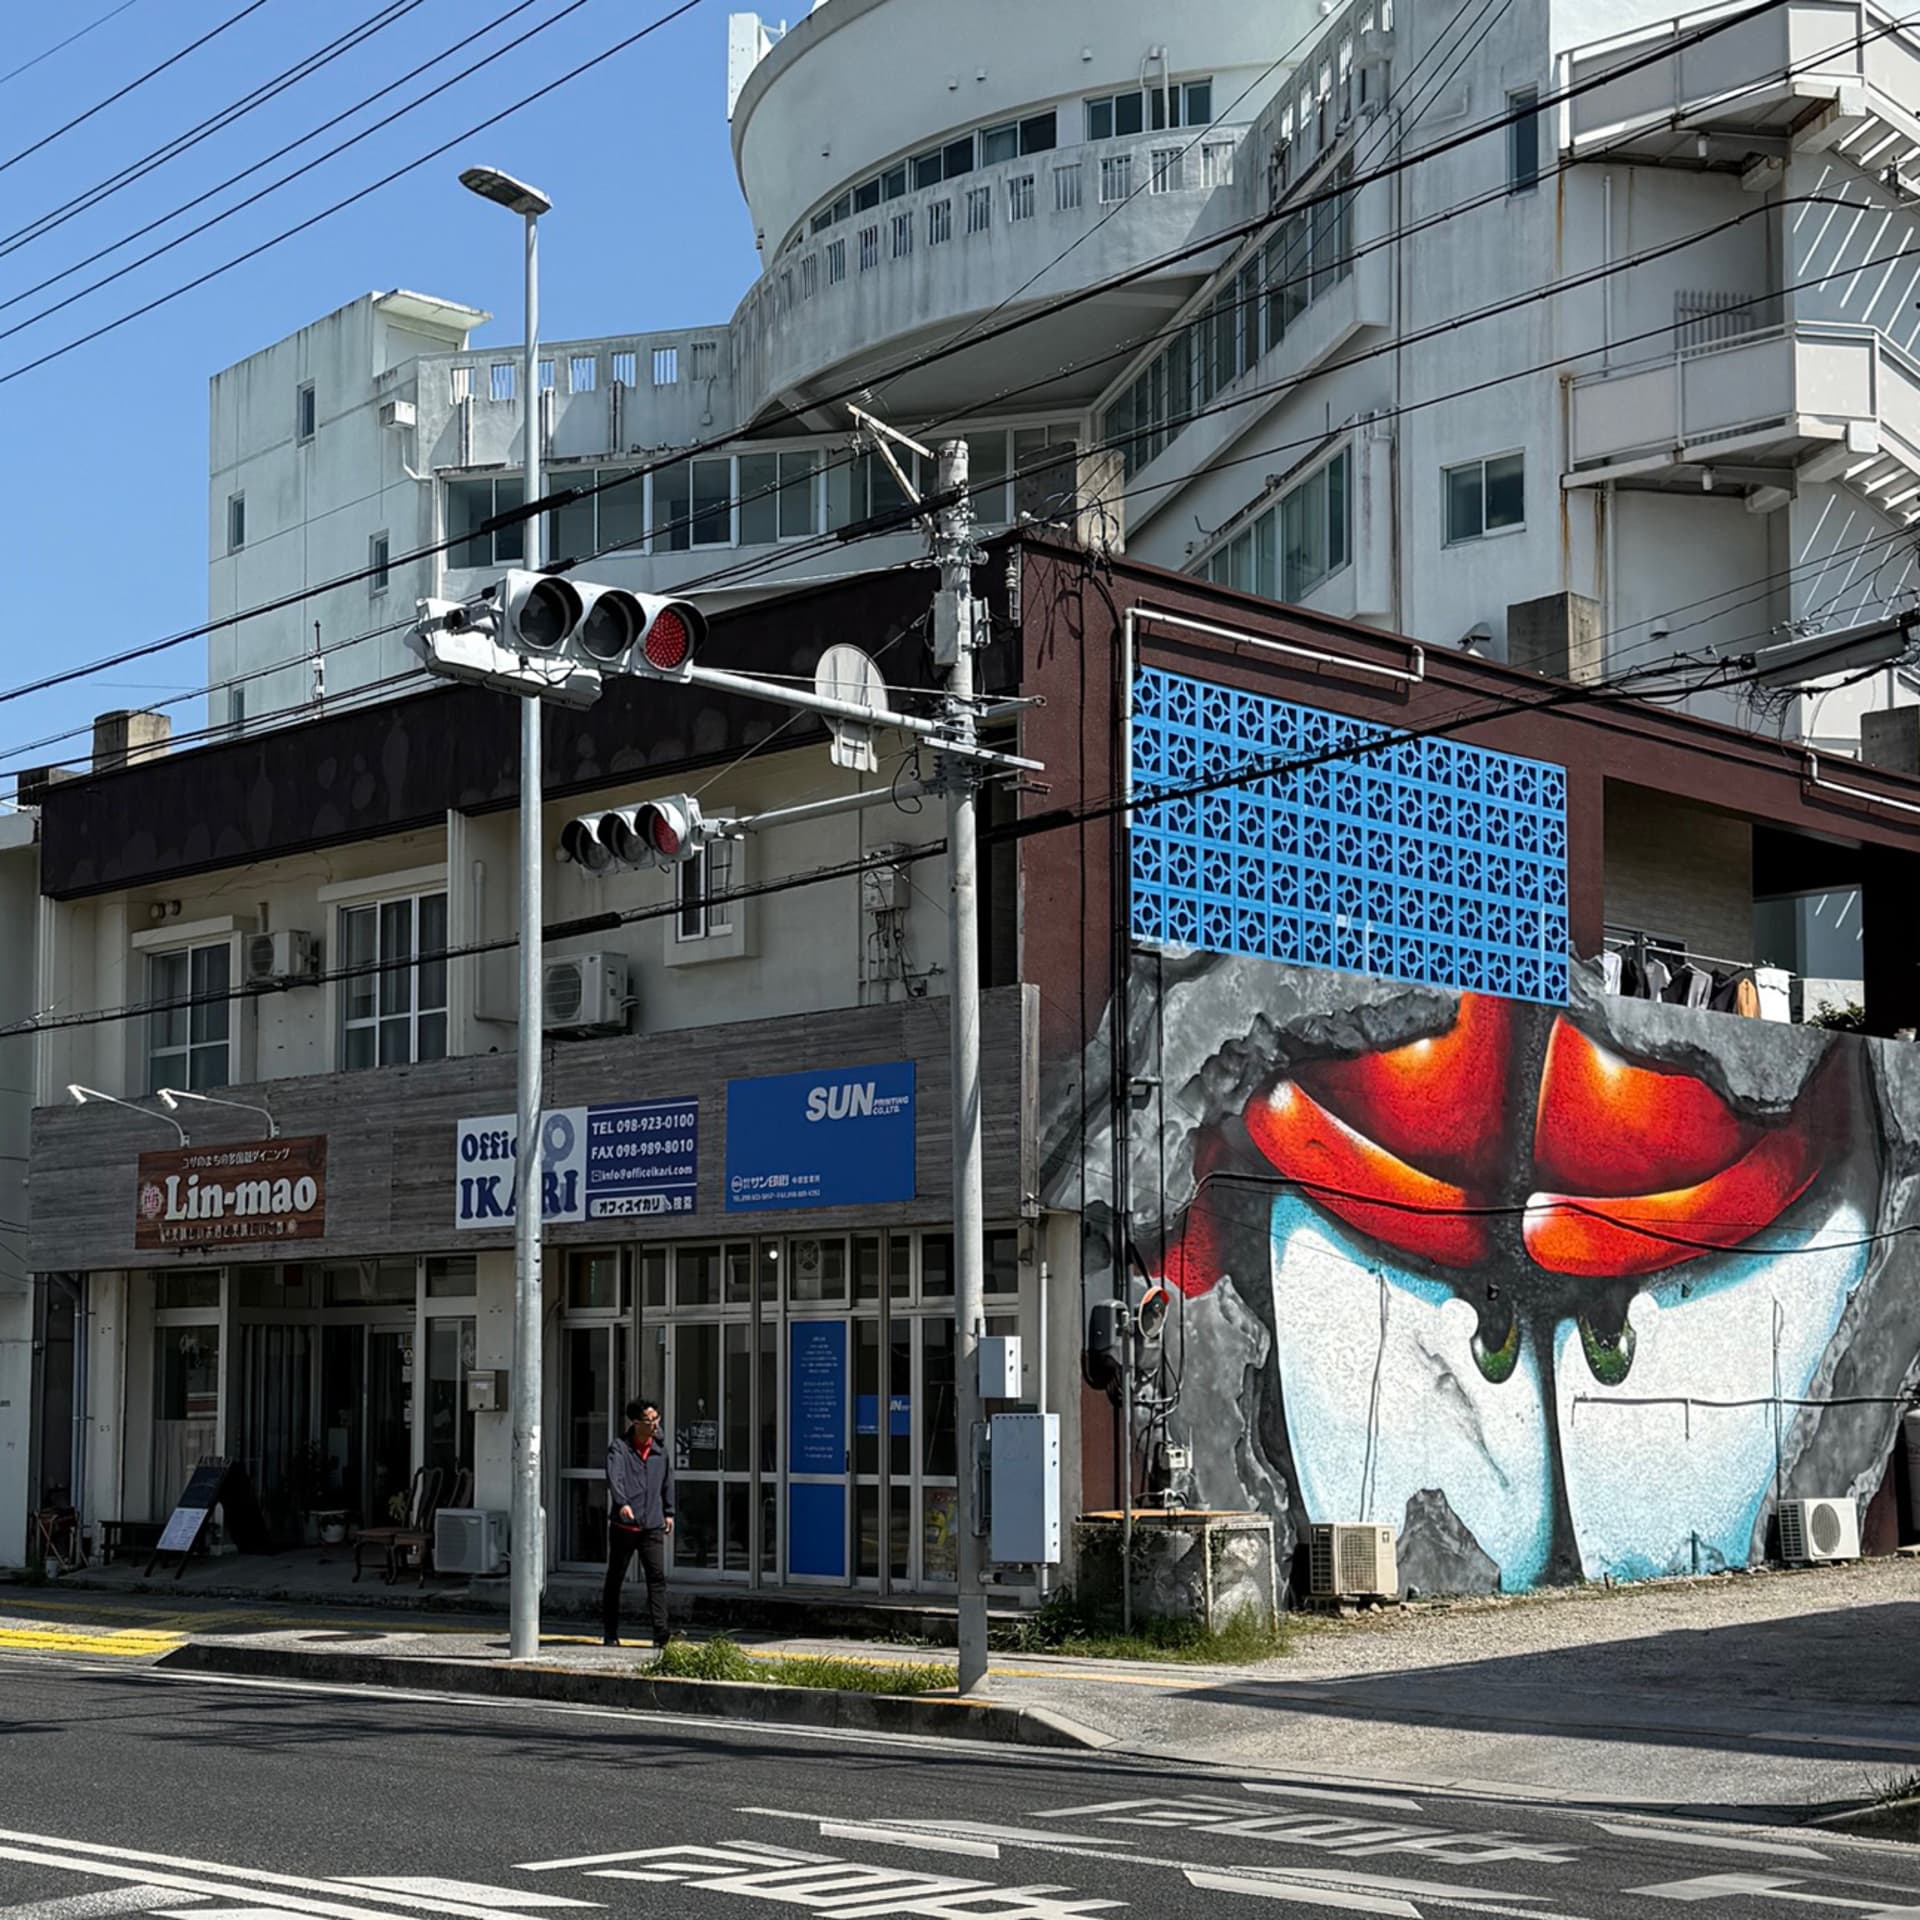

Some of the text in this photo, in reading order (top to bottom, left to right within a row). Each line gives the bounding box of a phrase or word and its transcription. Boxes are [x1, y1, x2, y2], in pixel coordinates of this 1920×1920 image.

[806, 1082, 876, 1121] SUN
[592, 1113, 694, 1135] TEL 098-923-0100
[461, 1131, 518, 1162] Offi
[591, 1138, 694, 1160] FAX 098-989-8010
[602, 1166, 693, 1181] info@officeikari.com
[164, 1174, 318, 1221] Lin-mao
[599, 1197, 661, 1214] オフィスイカリ
